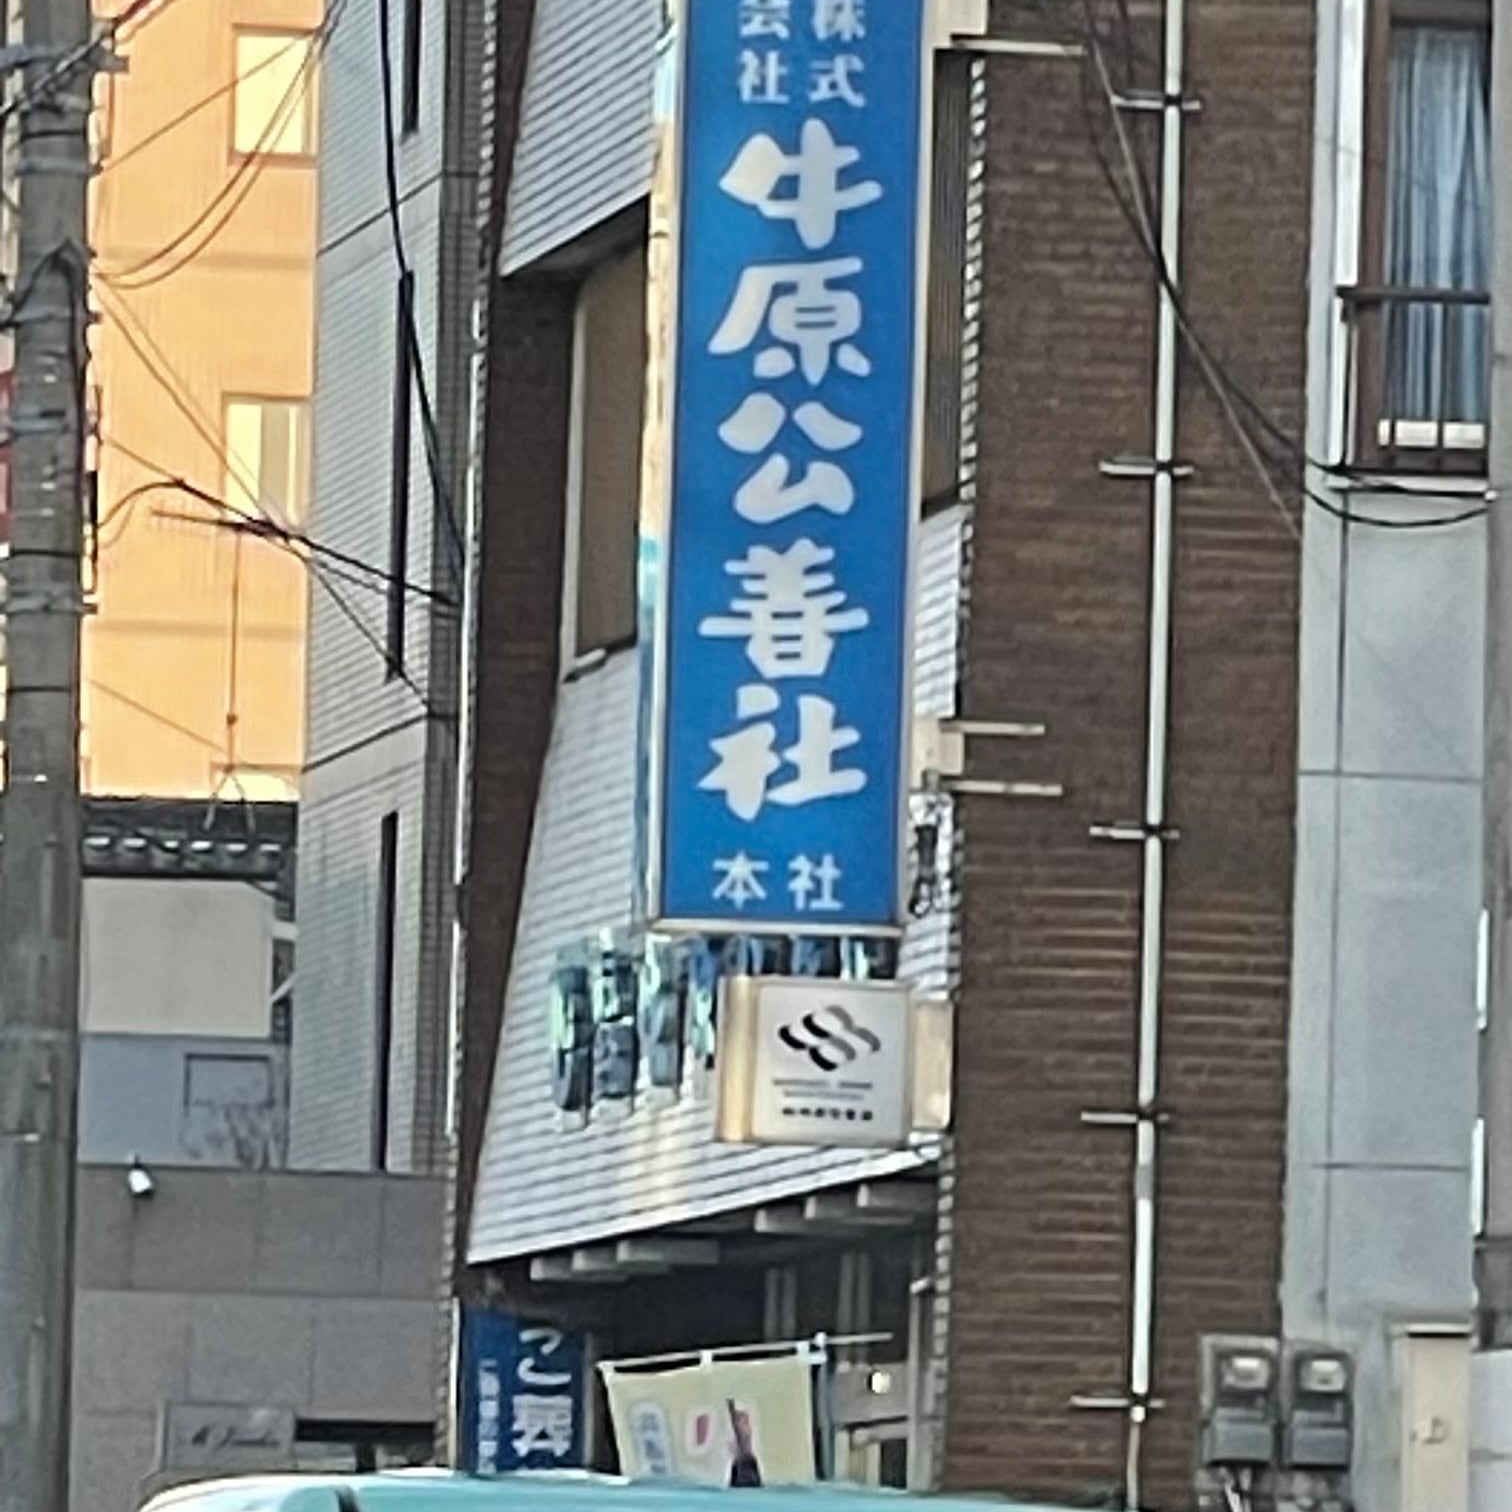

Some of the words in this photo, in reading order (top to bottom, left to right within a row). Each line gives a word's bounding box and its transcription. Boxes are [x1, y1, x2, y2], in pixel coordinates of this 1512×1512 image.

[698, 117, 884, 821] 牛原公善社
[712, 851, 845, 911] 本社
